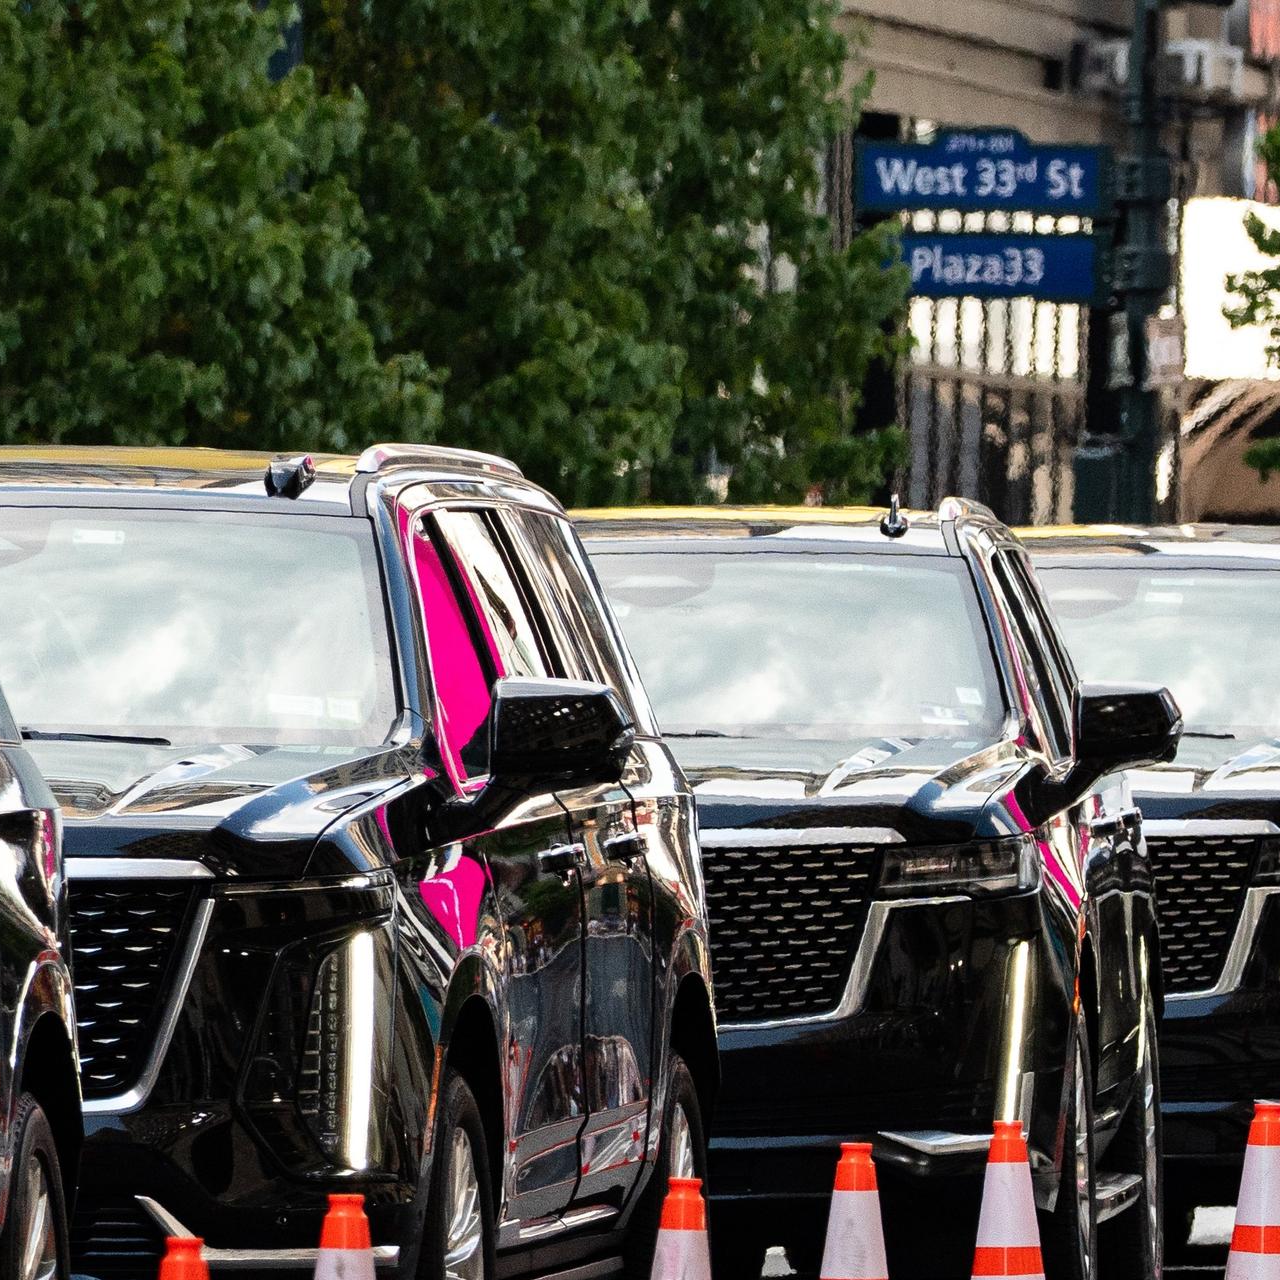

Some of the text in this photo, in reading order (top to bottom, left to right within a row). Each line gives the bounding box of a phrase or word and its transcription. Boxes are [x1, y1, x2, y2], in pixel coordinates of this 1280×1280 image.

[875, 156, 1086, 200] West 33rd St
[910, 245, 1046, 287] Plaza33
